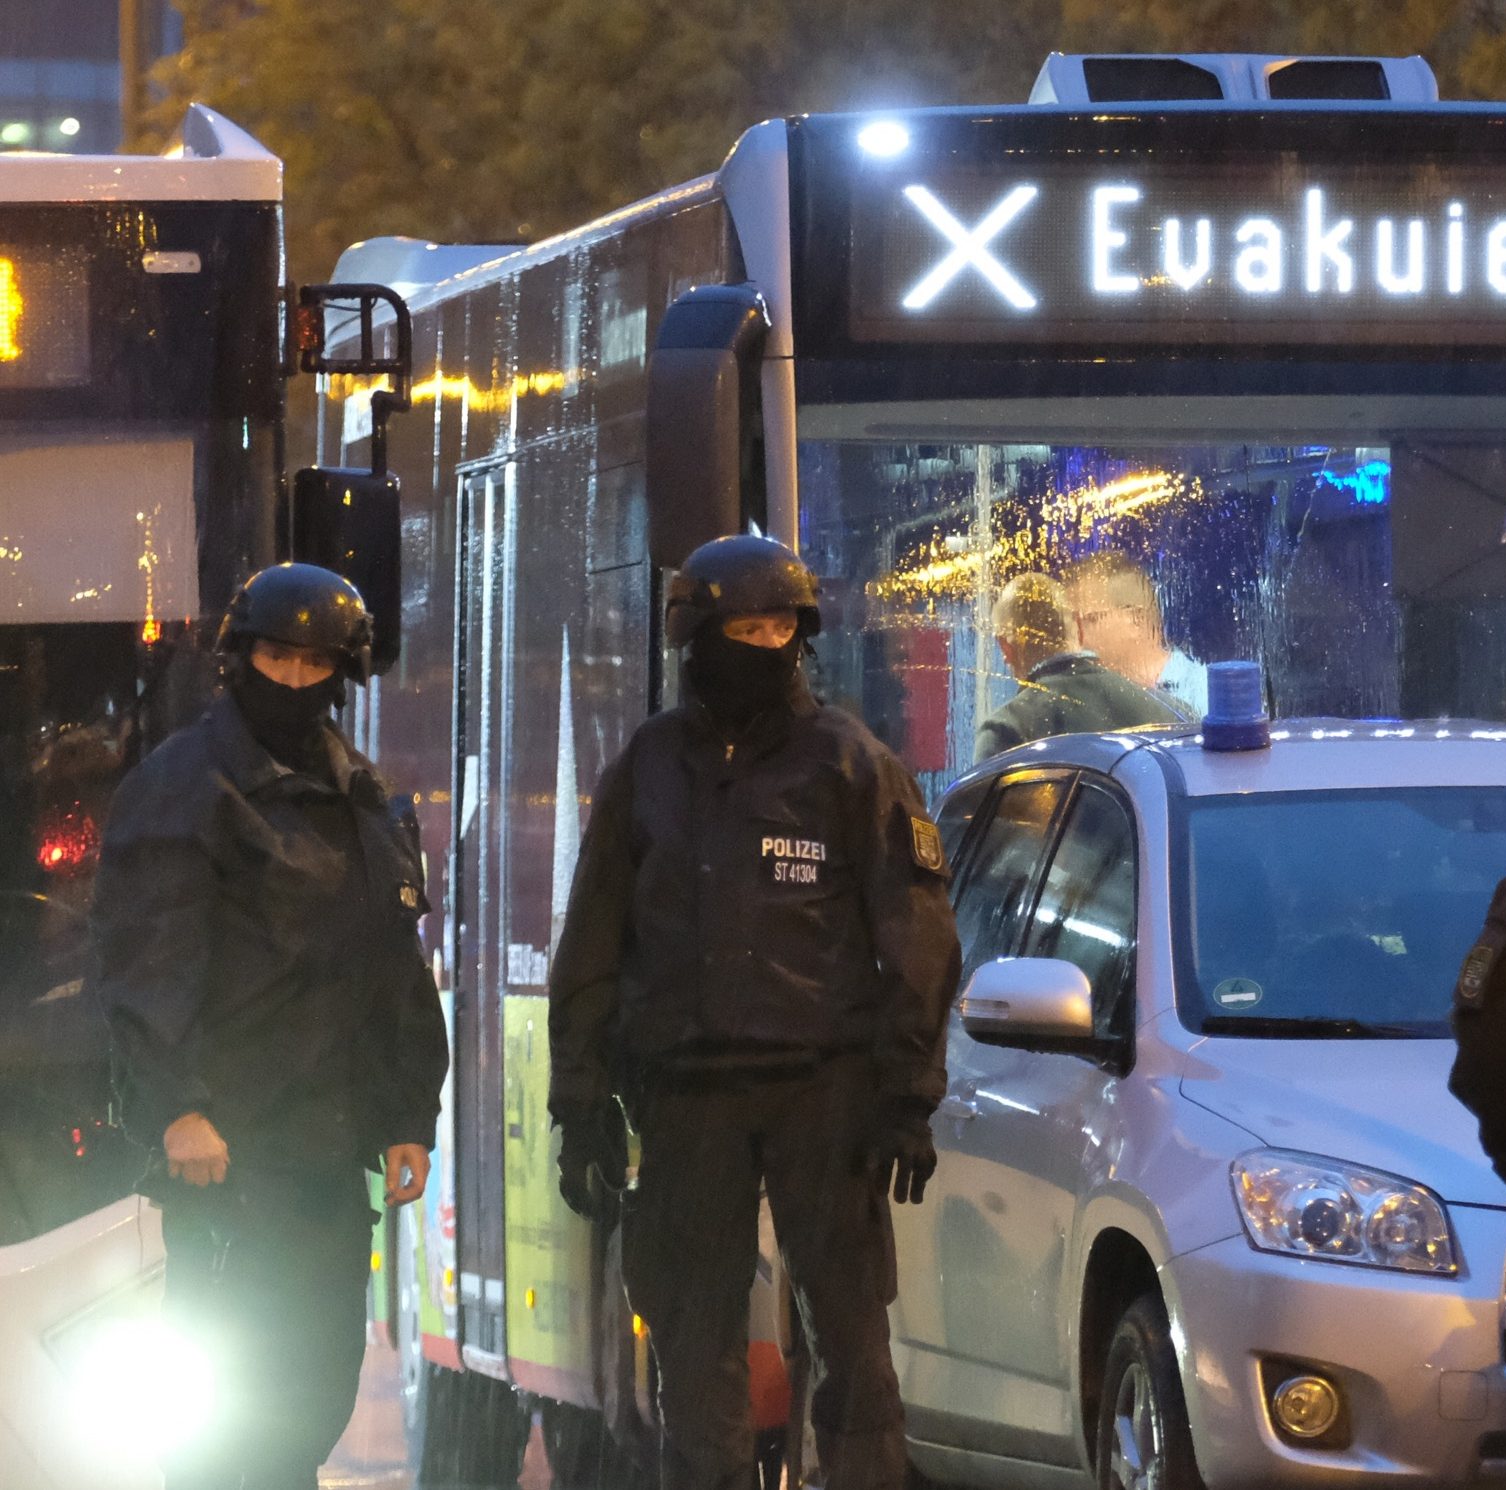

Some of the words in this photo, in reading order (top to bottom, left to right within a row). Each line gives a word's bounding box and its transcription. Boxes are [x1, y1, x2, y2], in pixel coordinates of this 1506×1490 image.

[761, 837, 826, 861] POLIZEI
[774, 862, 788, 881] ST
[789, 863, 817, 883] 41304
